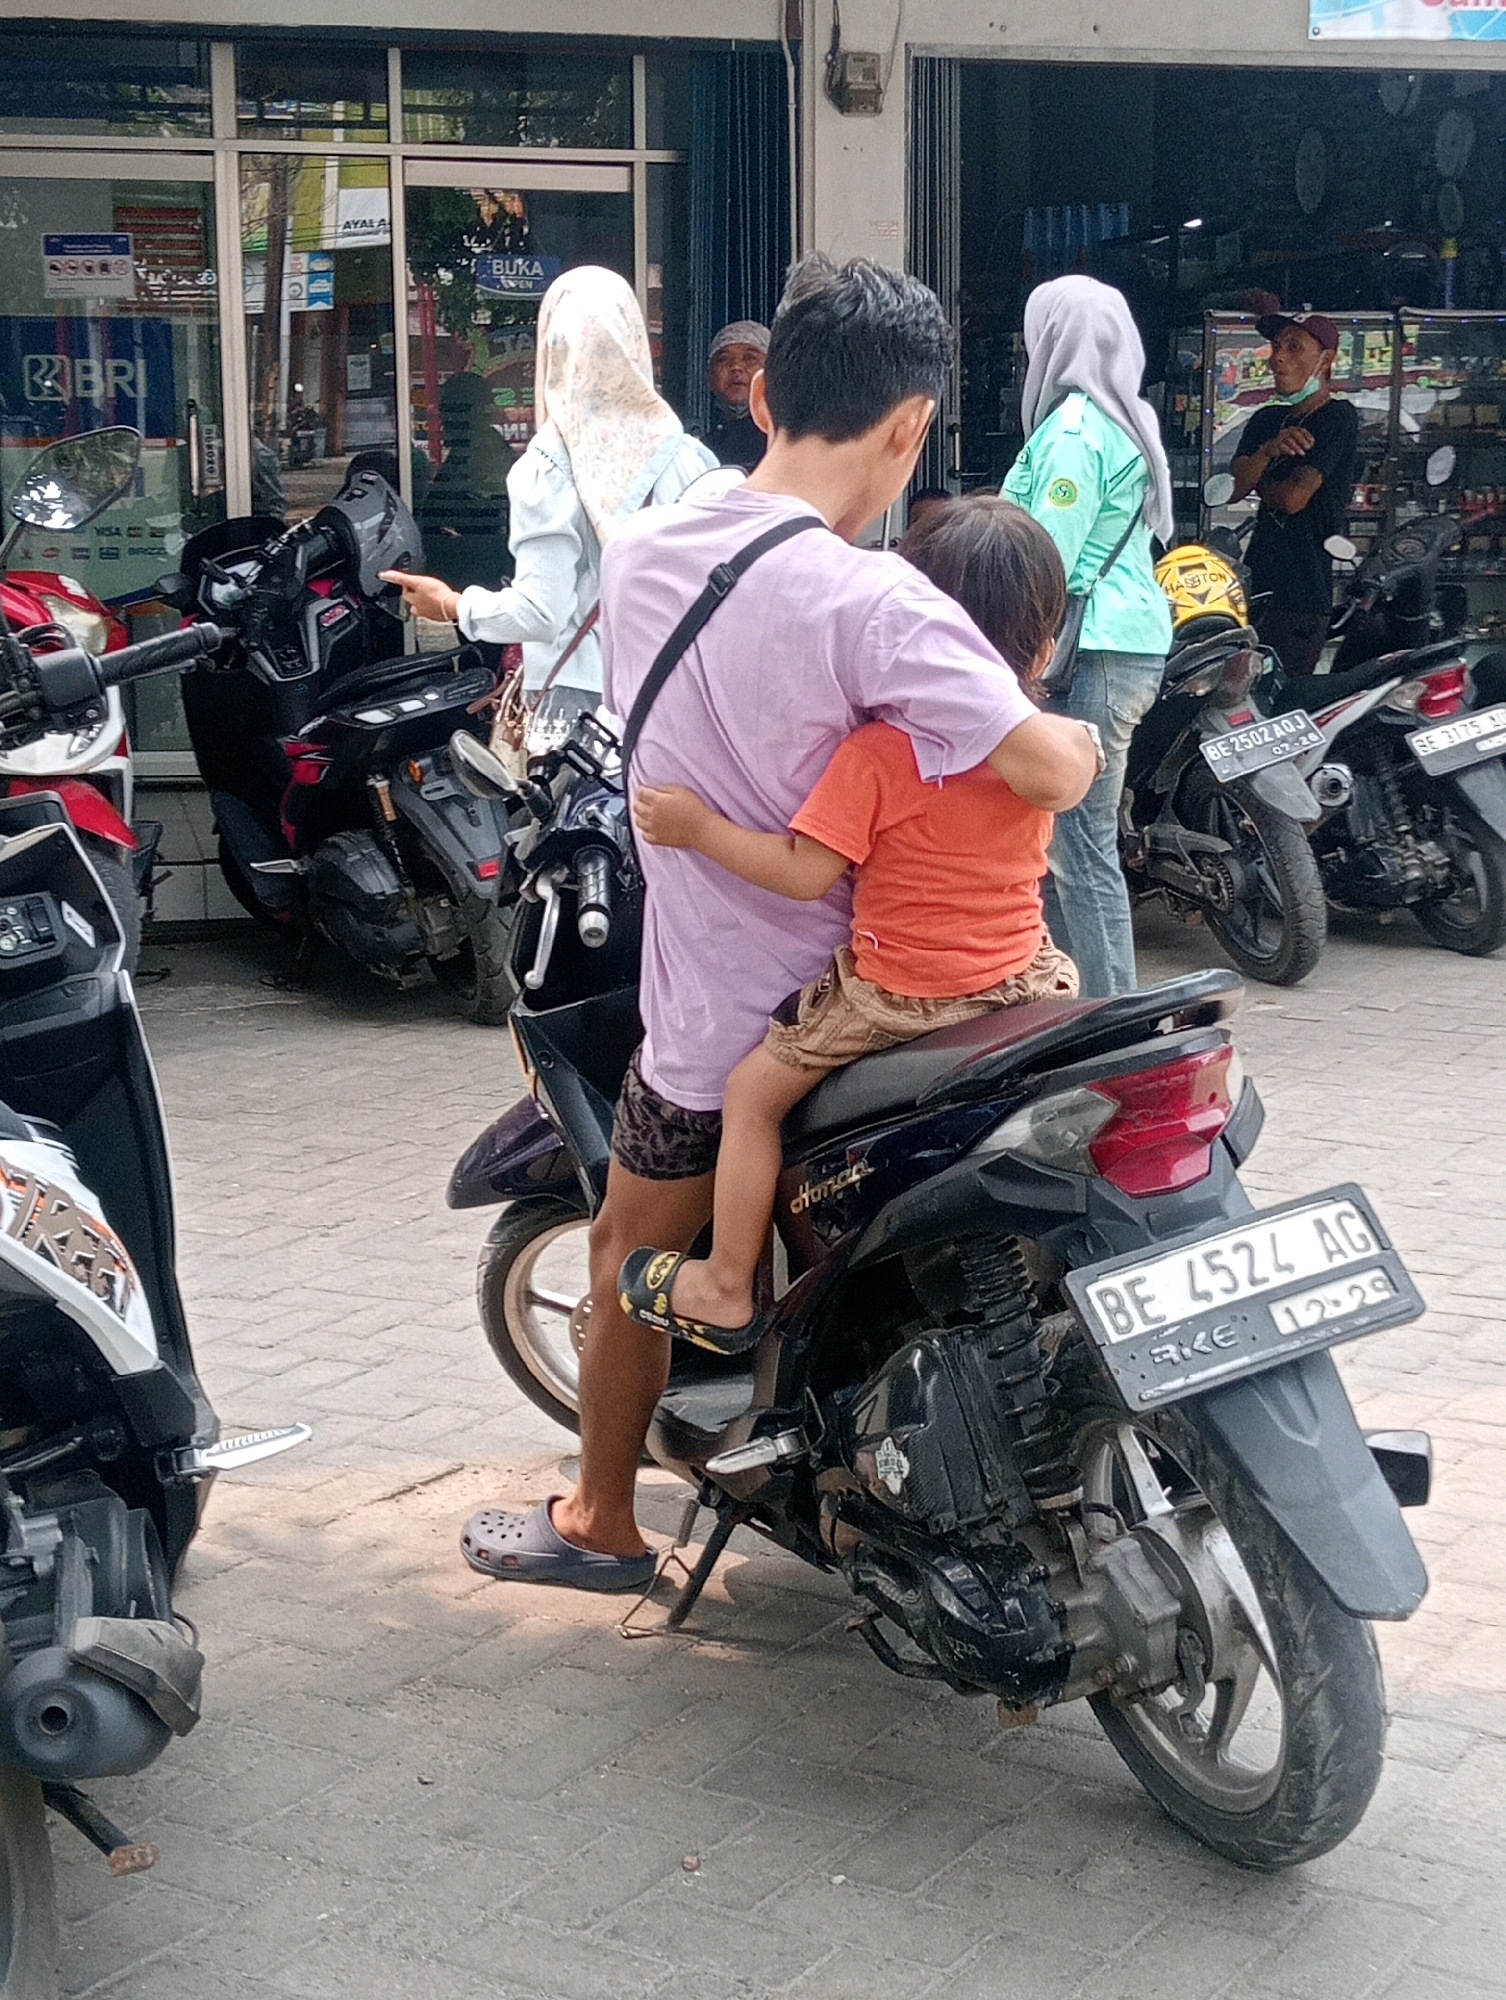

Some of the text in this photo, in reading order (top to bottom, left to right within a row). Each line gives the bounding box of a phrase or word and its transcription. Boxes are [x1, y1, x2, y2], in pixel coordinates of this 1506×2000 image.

[492, 258, 544, 276] BUKA
[74, 358, 147, 398] BRI
[1206, 741, 1232, 760] BE
[1229, 727, 1274, 752] 2502
[1415, 734, 1440, 753] BE
[1441, 720, 1482, 744] 3175
[1095, 1275, 1167, 1336] BE
[1186, 1232, 1295, 1303] 4524
